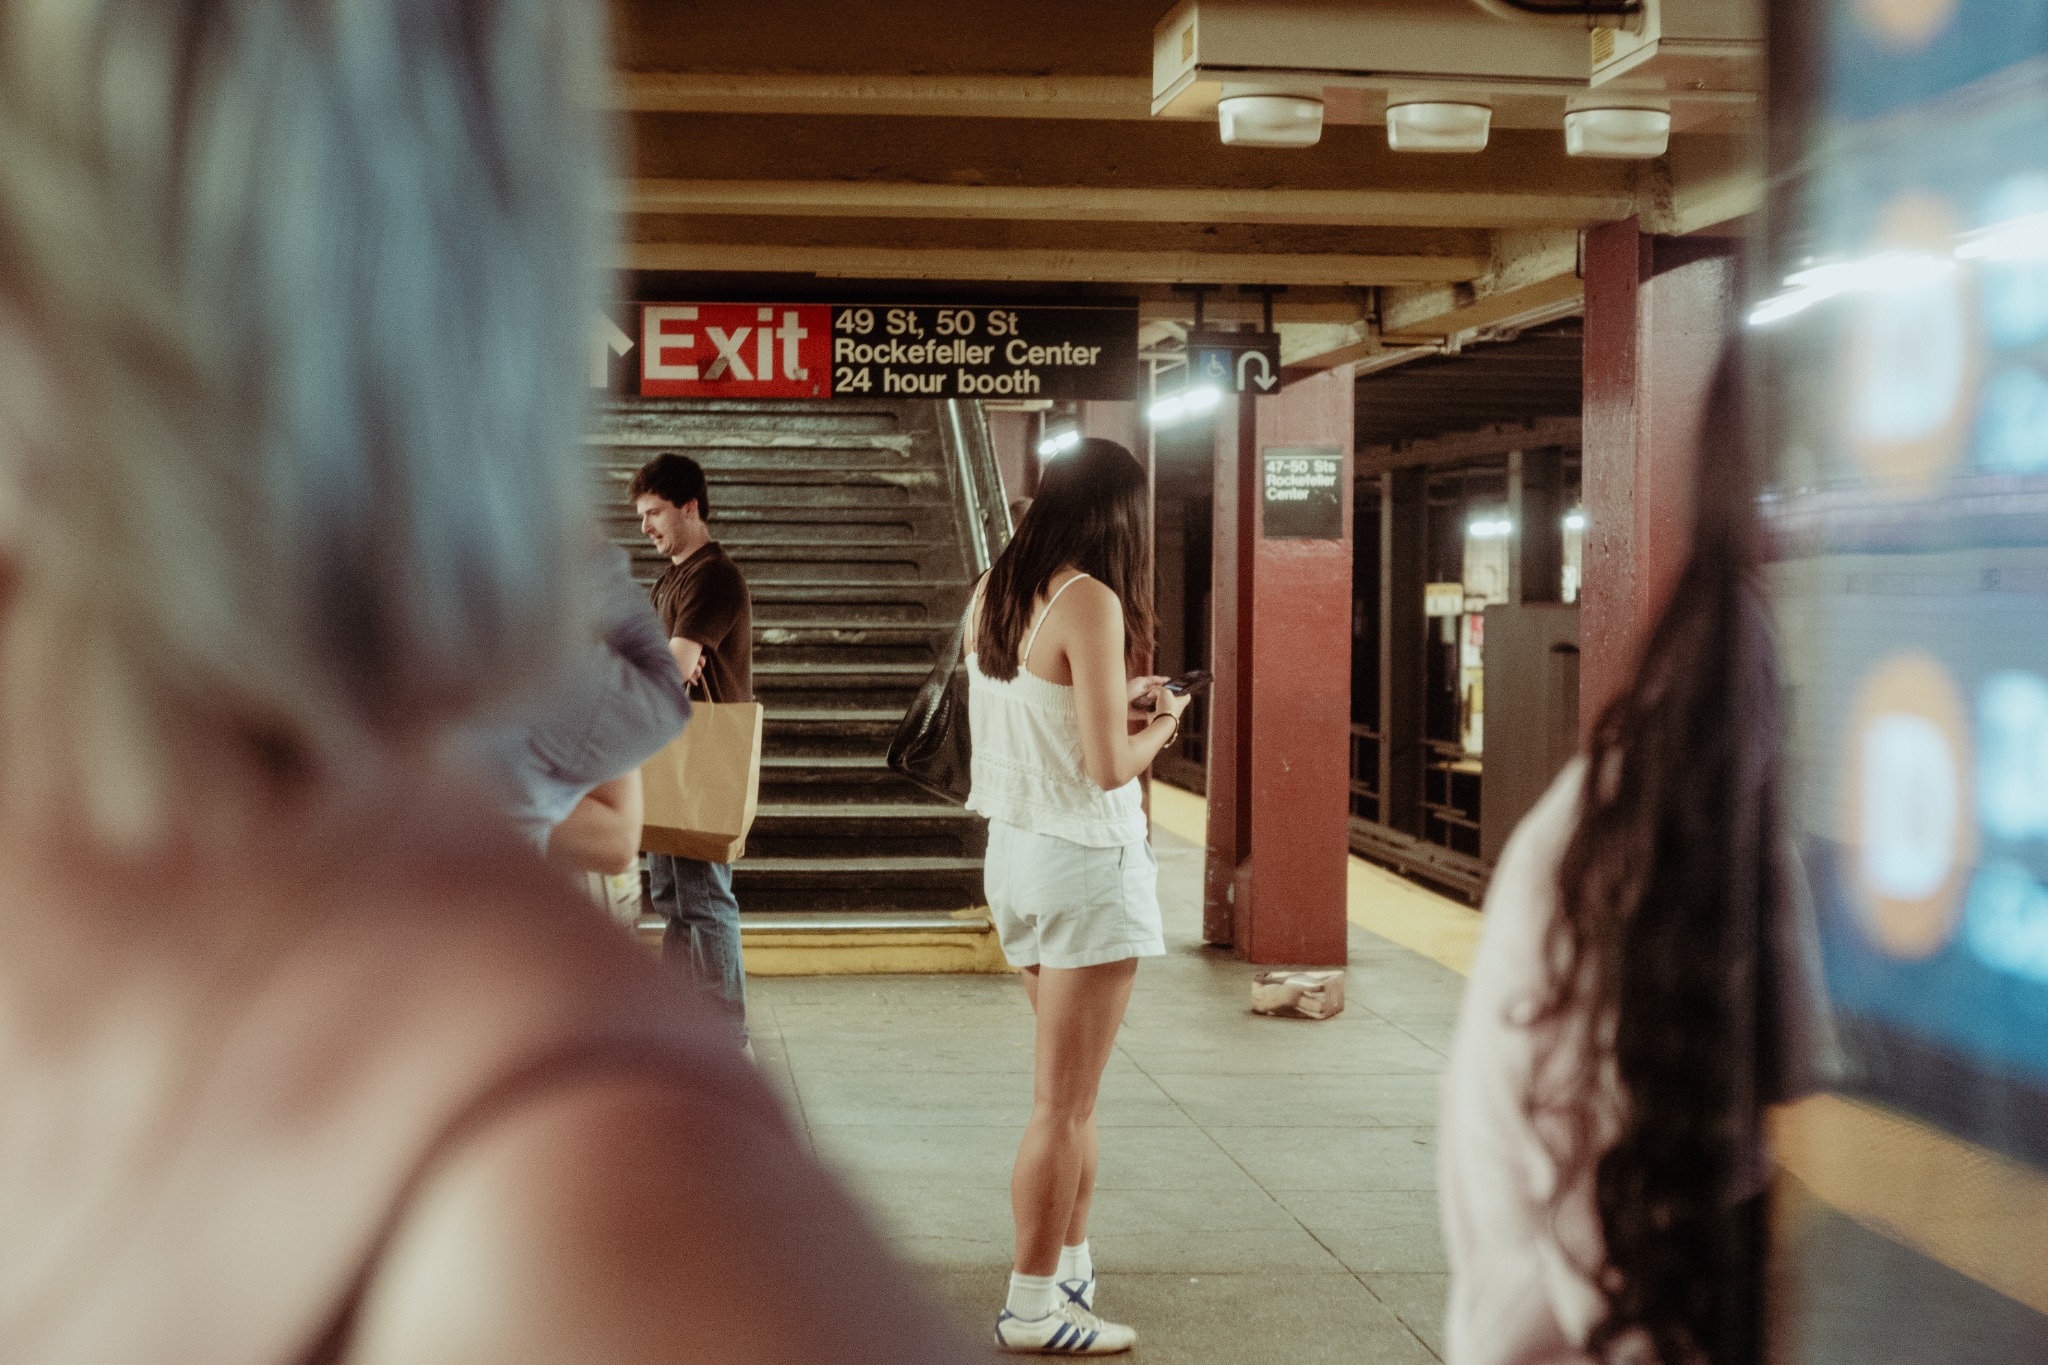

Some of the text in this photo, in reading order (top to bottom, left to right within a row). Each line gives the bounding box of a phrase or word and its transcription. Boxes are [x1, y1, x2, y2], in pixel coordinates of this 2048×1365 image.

[835, 308, 1019, 340] 49 St, 50 St
[643, 305, 809, 381] Exit
[834, 337, 1102, 367] Rockefeller Center
[834, 366, 1041, 395] 24 hour booth
[1265, 460, 1337, 474] 47-50 Sts
[1265, 473, 1337, 487] Rockefeller
[1265, 487, 1310, 501] Center
